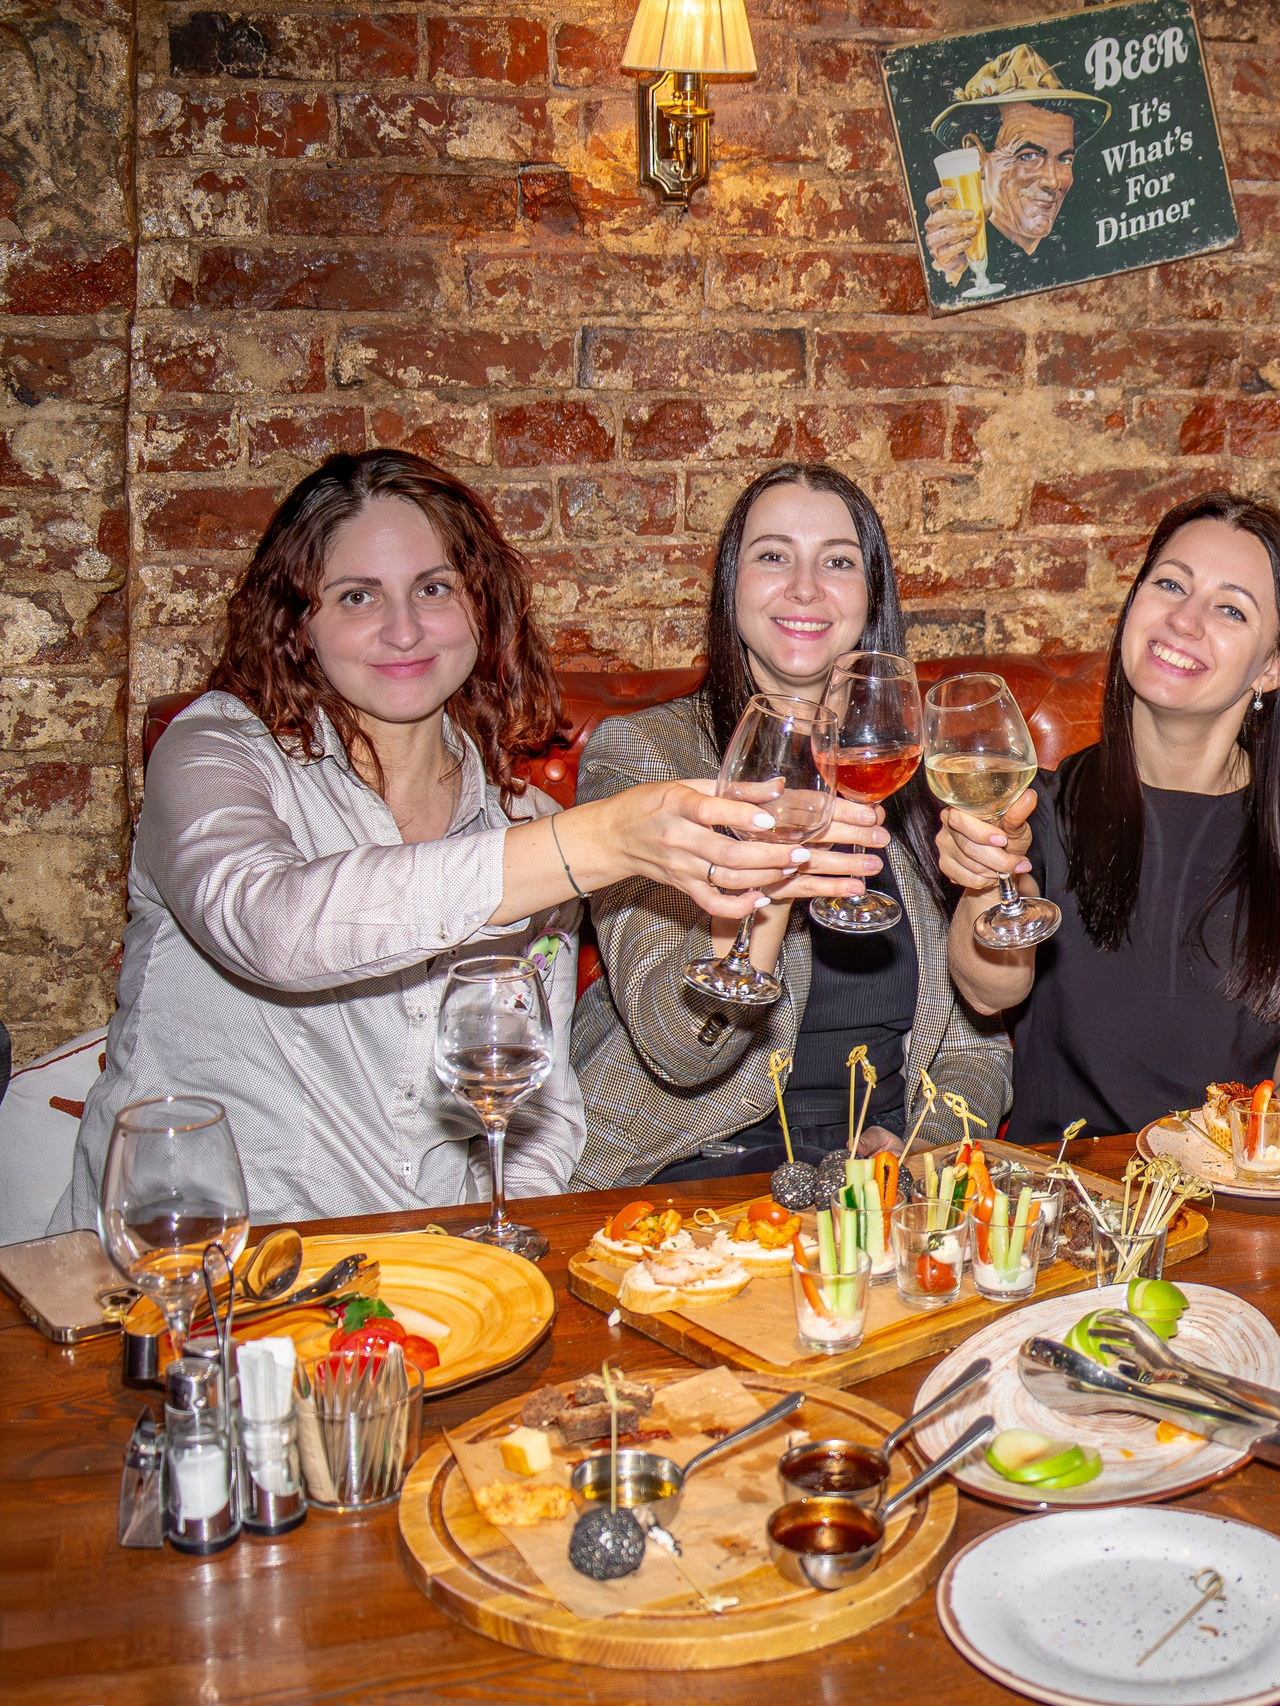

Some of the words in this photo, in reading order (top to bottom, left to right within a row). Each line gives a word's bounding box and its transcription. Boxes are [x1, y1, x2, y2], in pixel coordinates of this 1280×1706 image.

[1084, 27, 1188, 90] BEER
[1128, 97, 1172, 133] It's
[1101, 126, 1194, 176] What's
[1125, 173, 1175, 206] For
[1095, 198, 1196, 248] Dinner
